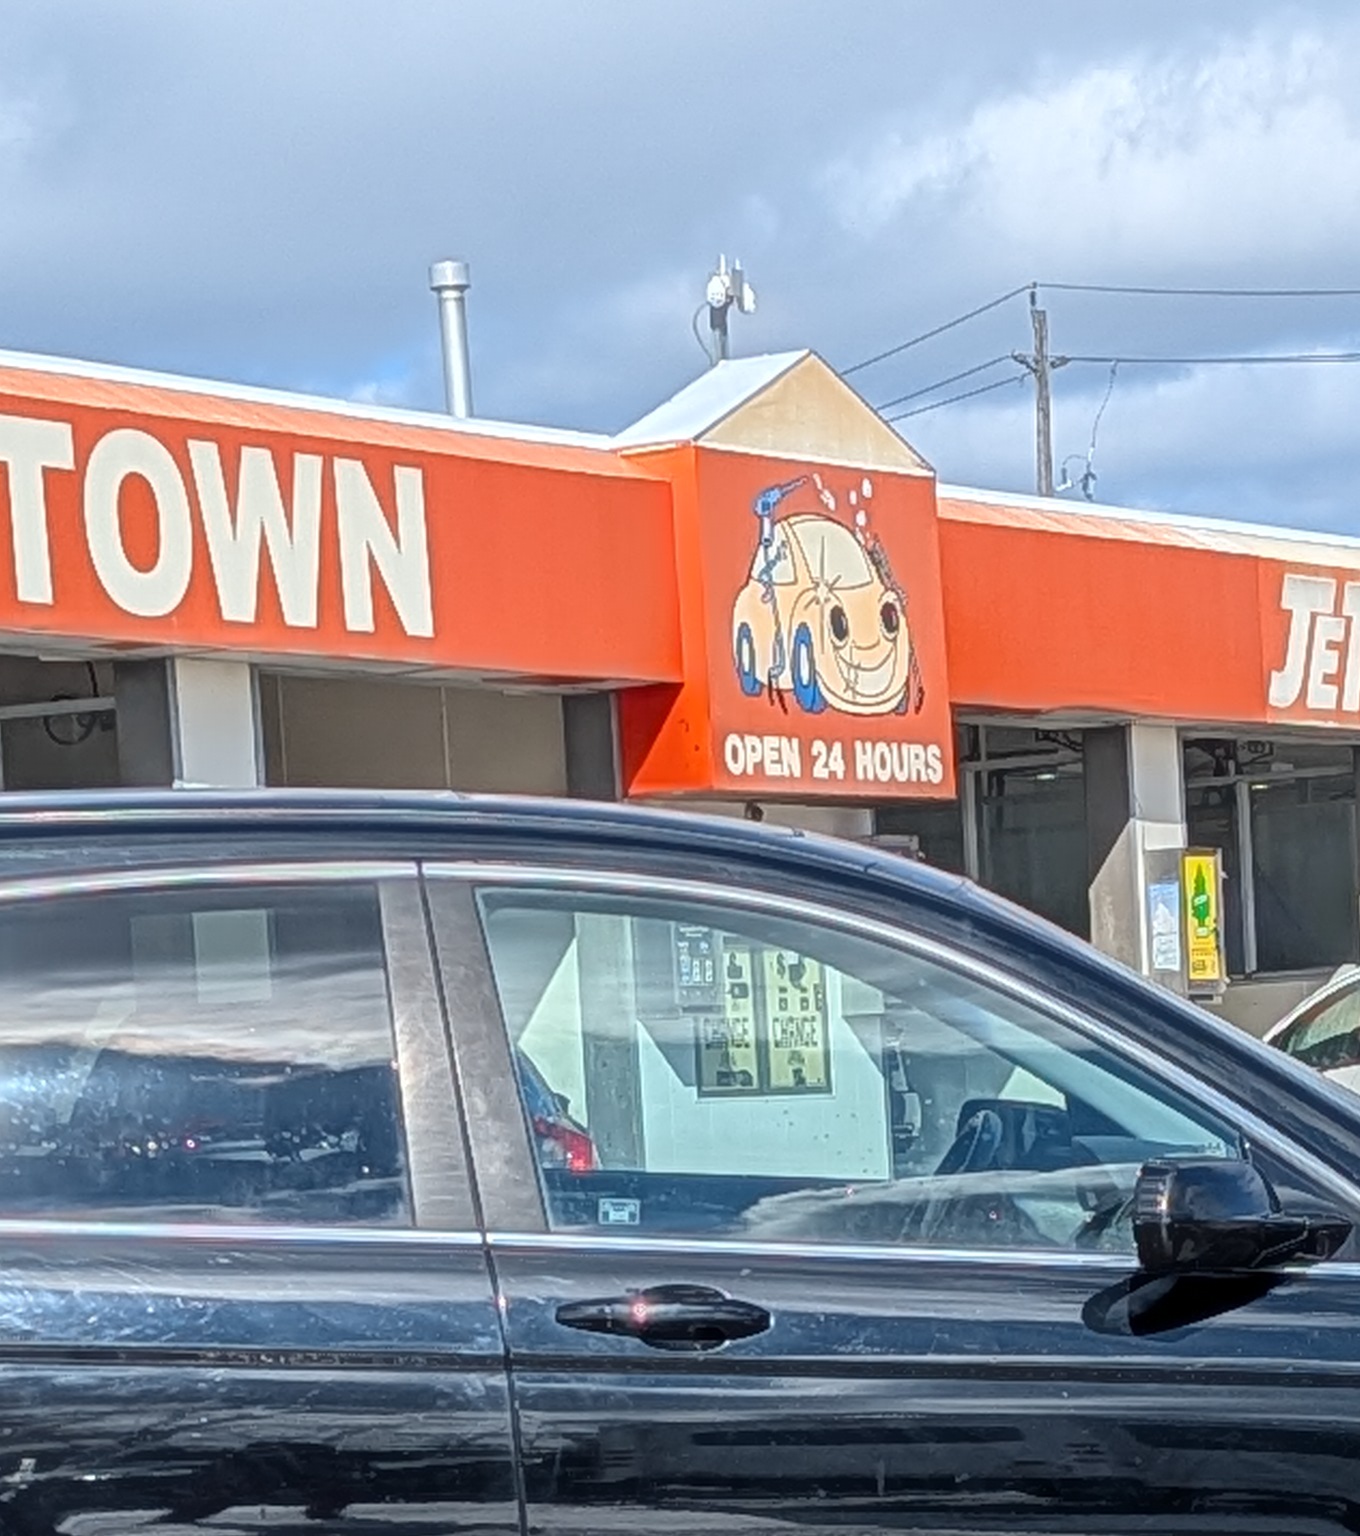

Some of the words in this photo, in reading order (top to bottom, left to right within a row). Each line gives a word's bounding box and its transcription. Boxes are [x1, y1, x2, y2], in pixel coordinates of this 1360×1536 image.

[724, 733, 802, 778] OPEN
[811, 739, 846, 780] 24
[854, 739, 944, 784] HOURS
